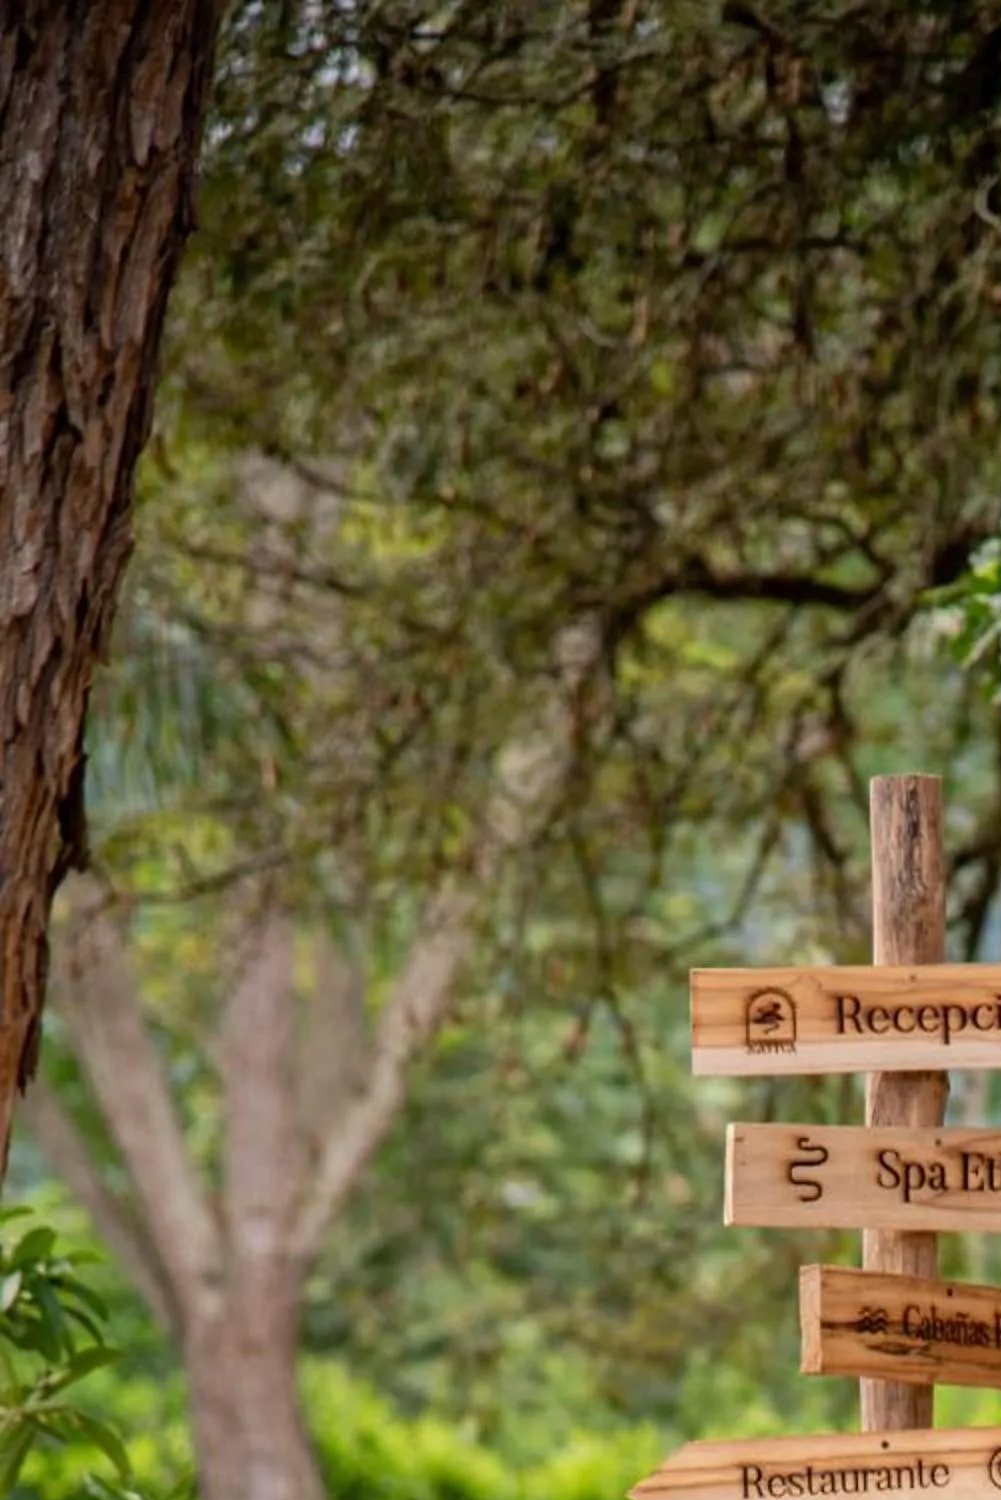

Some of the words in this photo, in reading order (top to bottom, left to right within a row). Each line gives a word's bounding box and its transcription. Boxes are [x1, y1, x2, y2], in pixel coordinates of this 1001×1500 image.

[876, 1151, 948, 1202] Spa
[903, 1304, 990, 1348] Cabañas
[741, 1459, 950, 1499] Restaurante
